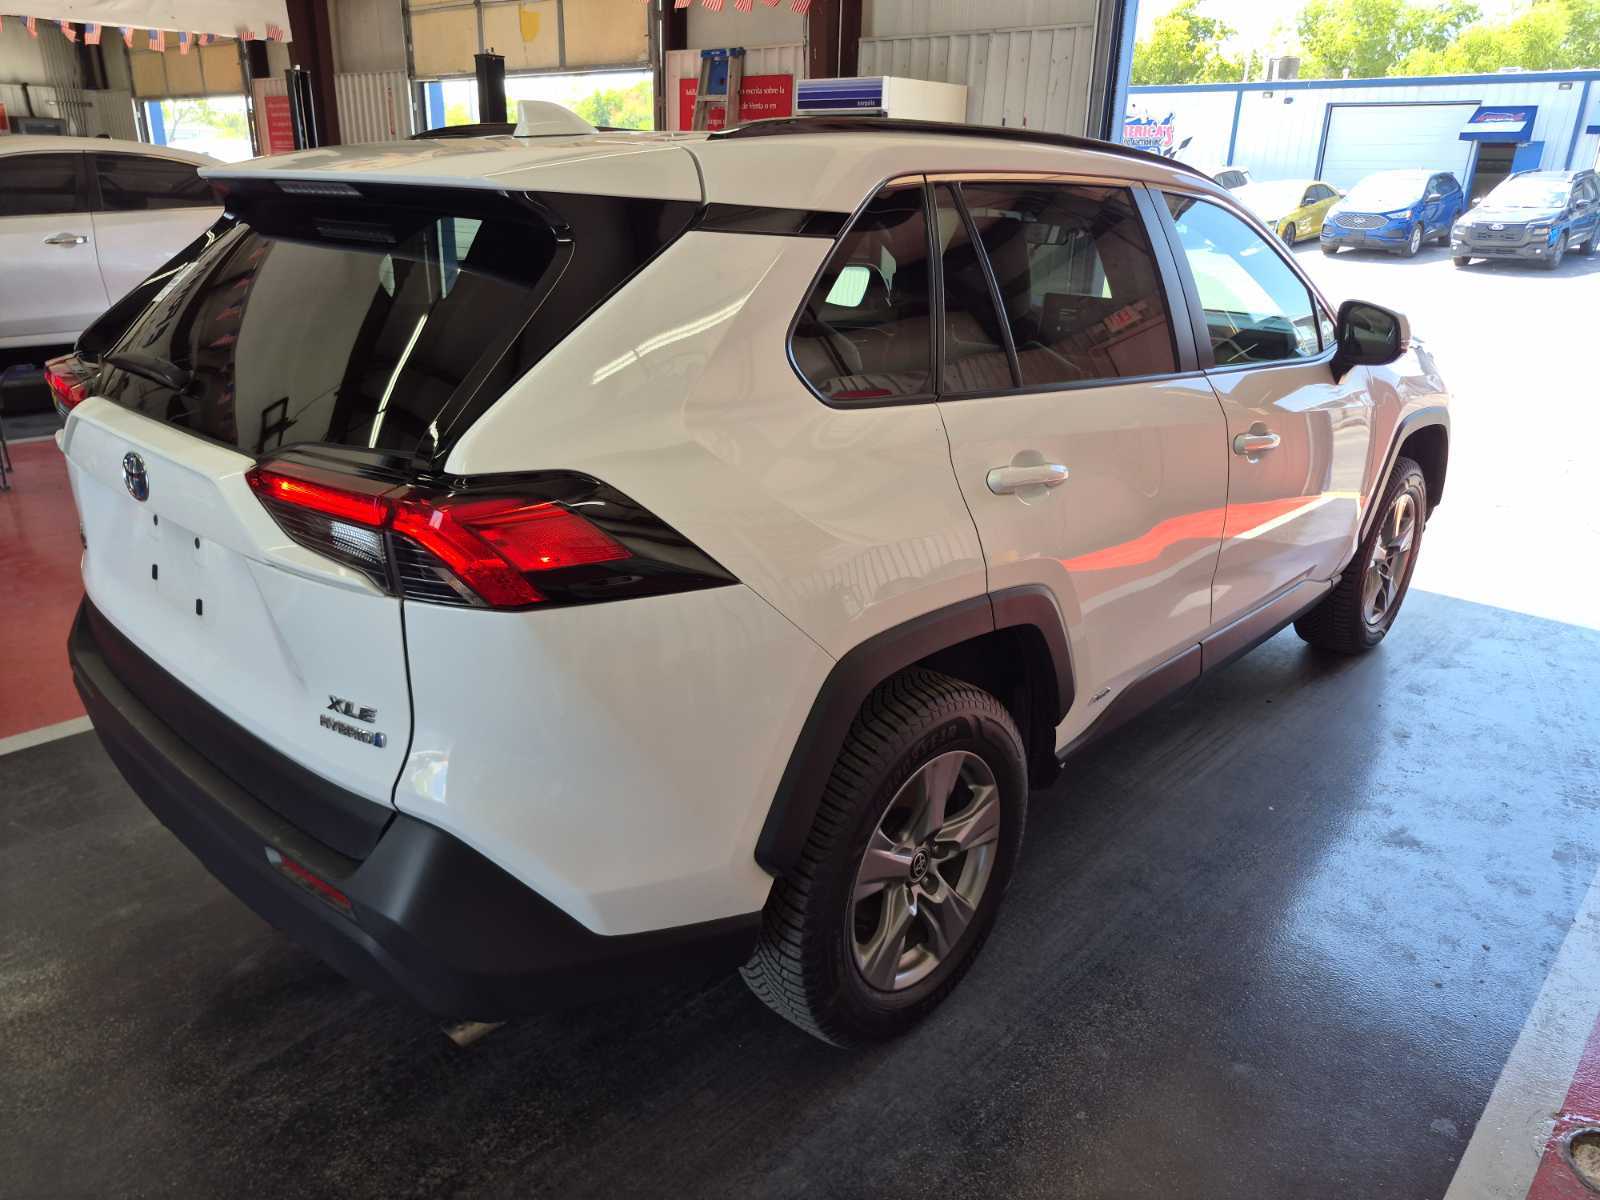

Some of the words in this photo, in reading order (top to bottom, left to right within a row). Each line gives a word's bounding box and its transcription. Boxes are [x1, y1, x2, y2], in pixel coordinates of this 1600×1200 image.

[763, 85, 778, 95] sobre
[779, 84, 785, 94] la
[327, 695, 377, 723] XLE
